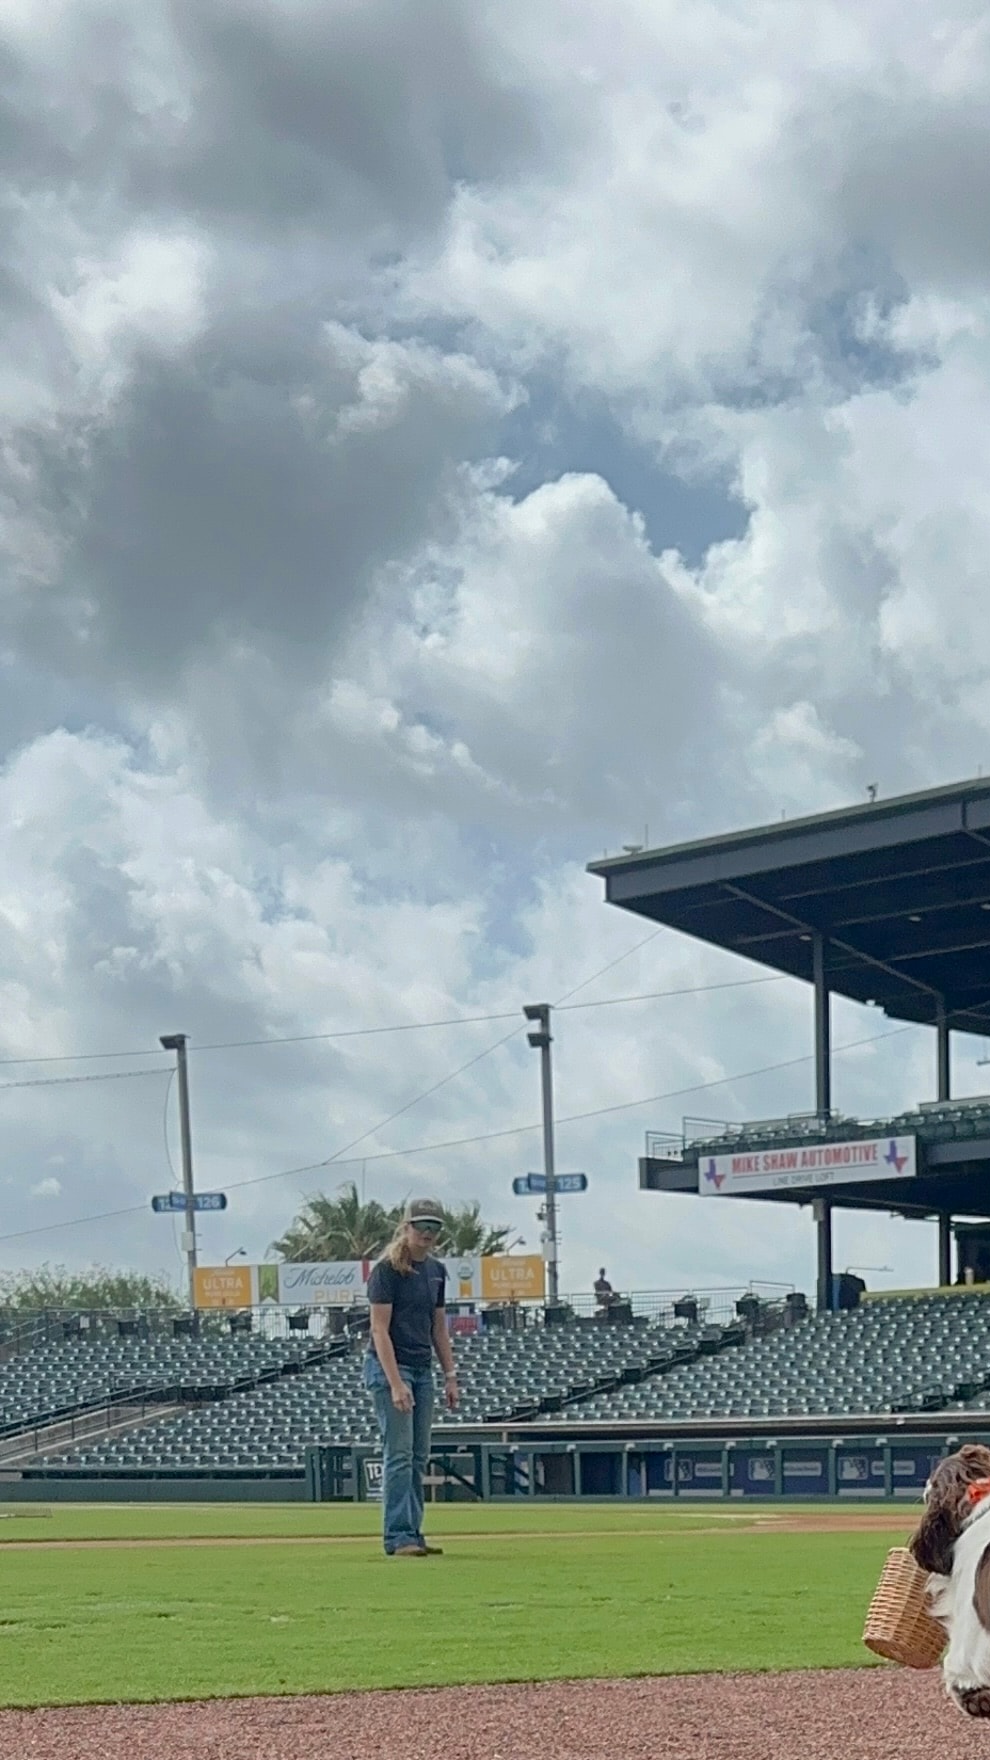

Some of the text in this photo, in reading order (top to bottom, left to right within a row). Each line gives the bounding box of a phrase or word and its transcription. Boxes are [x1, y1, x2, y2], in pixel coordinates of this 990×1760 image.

[732, 1143, 878, 1174] MIKE SHAW AUTOMOTIVE
[559, 1177, 582, 1191] 125
[197, 1196, 220, 1210] 126
[283, 1266, 356, 1289] Michelob
[490, 1267, 535, 1281] ULTRA
[203, 1277, 244, 1290] ULTRA
